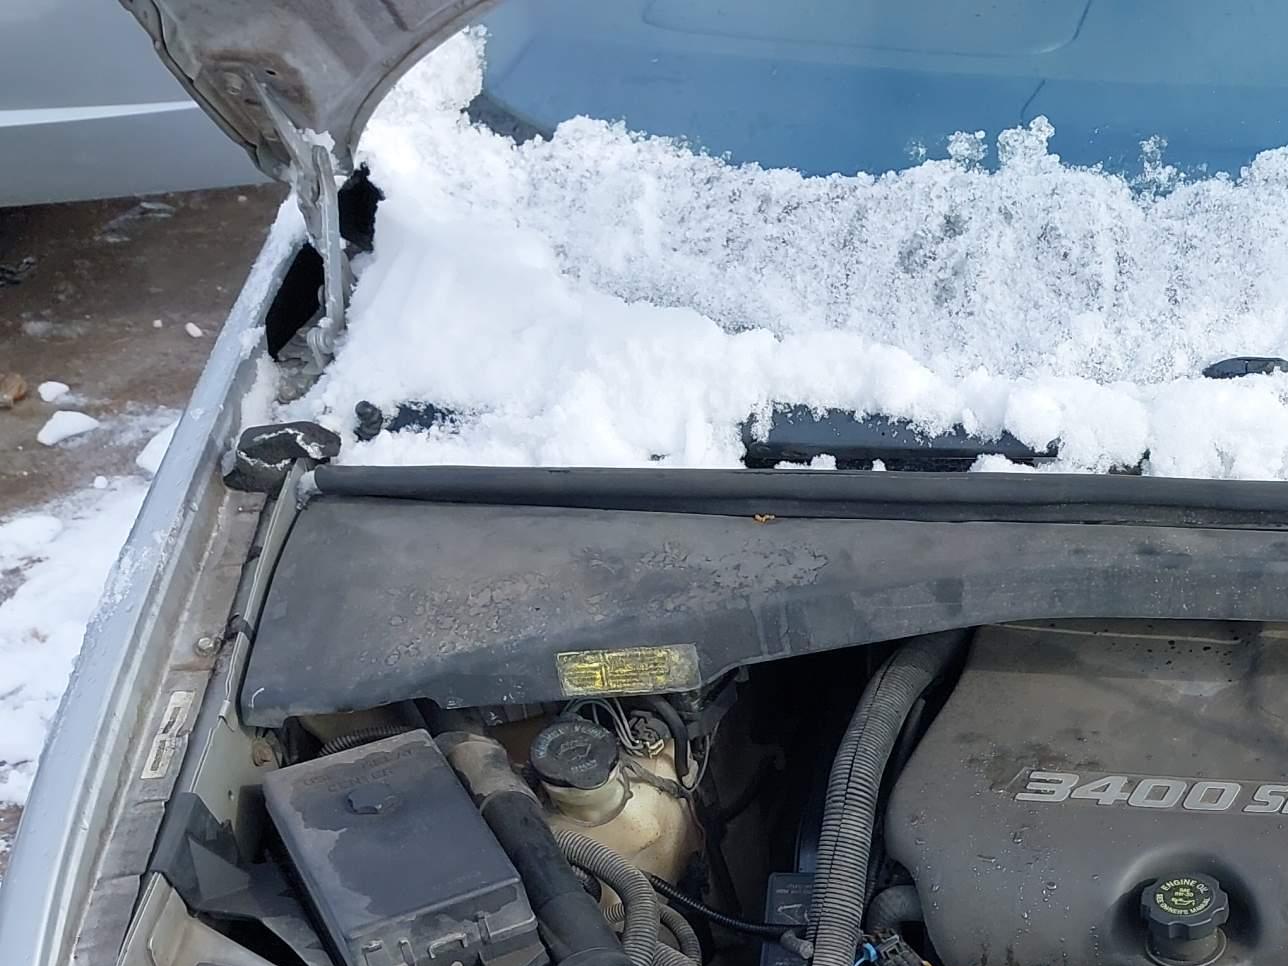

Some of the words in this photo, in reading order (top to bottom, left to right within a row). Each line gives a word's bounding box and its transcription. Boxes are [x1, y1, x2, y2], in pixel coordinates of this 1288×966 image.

[1014, 771, 1241, 811] 3400
[1160, 878, 1196, 890] ENGINE
[1196, 883, 1208, 893] OIL
